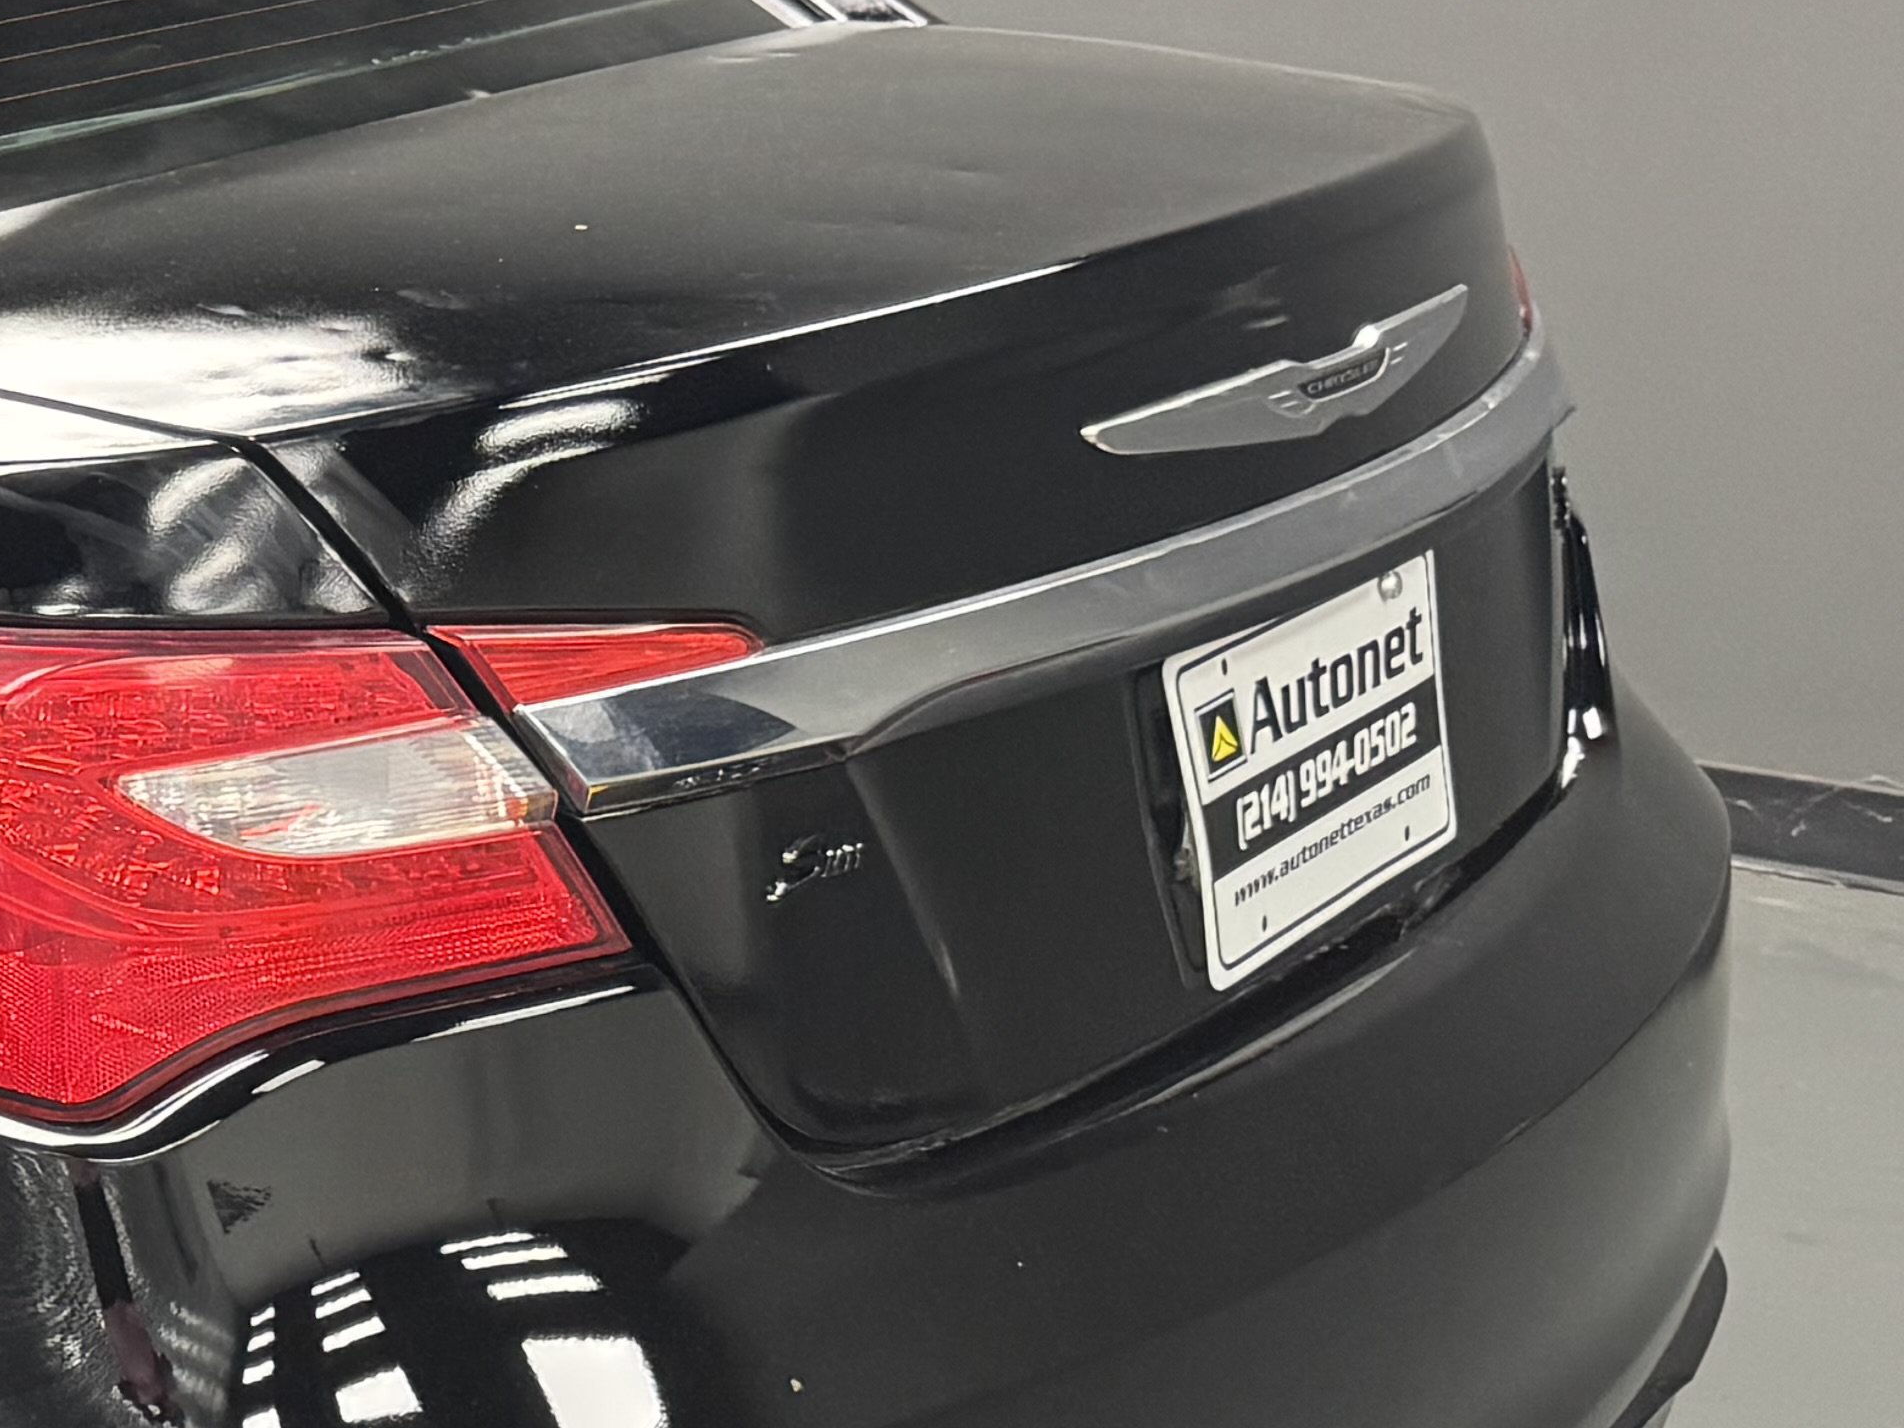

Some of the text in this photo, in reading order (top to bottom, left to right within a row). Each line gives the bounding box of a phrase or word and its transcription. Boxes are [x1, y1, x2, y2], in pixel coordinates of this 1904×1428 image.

[1248, 606, 1425, 757] Autonet
[1233, 773, 1432, 907] www.autonettexas.com
[1235, 701, 1418, 850] (214) 994-0502
